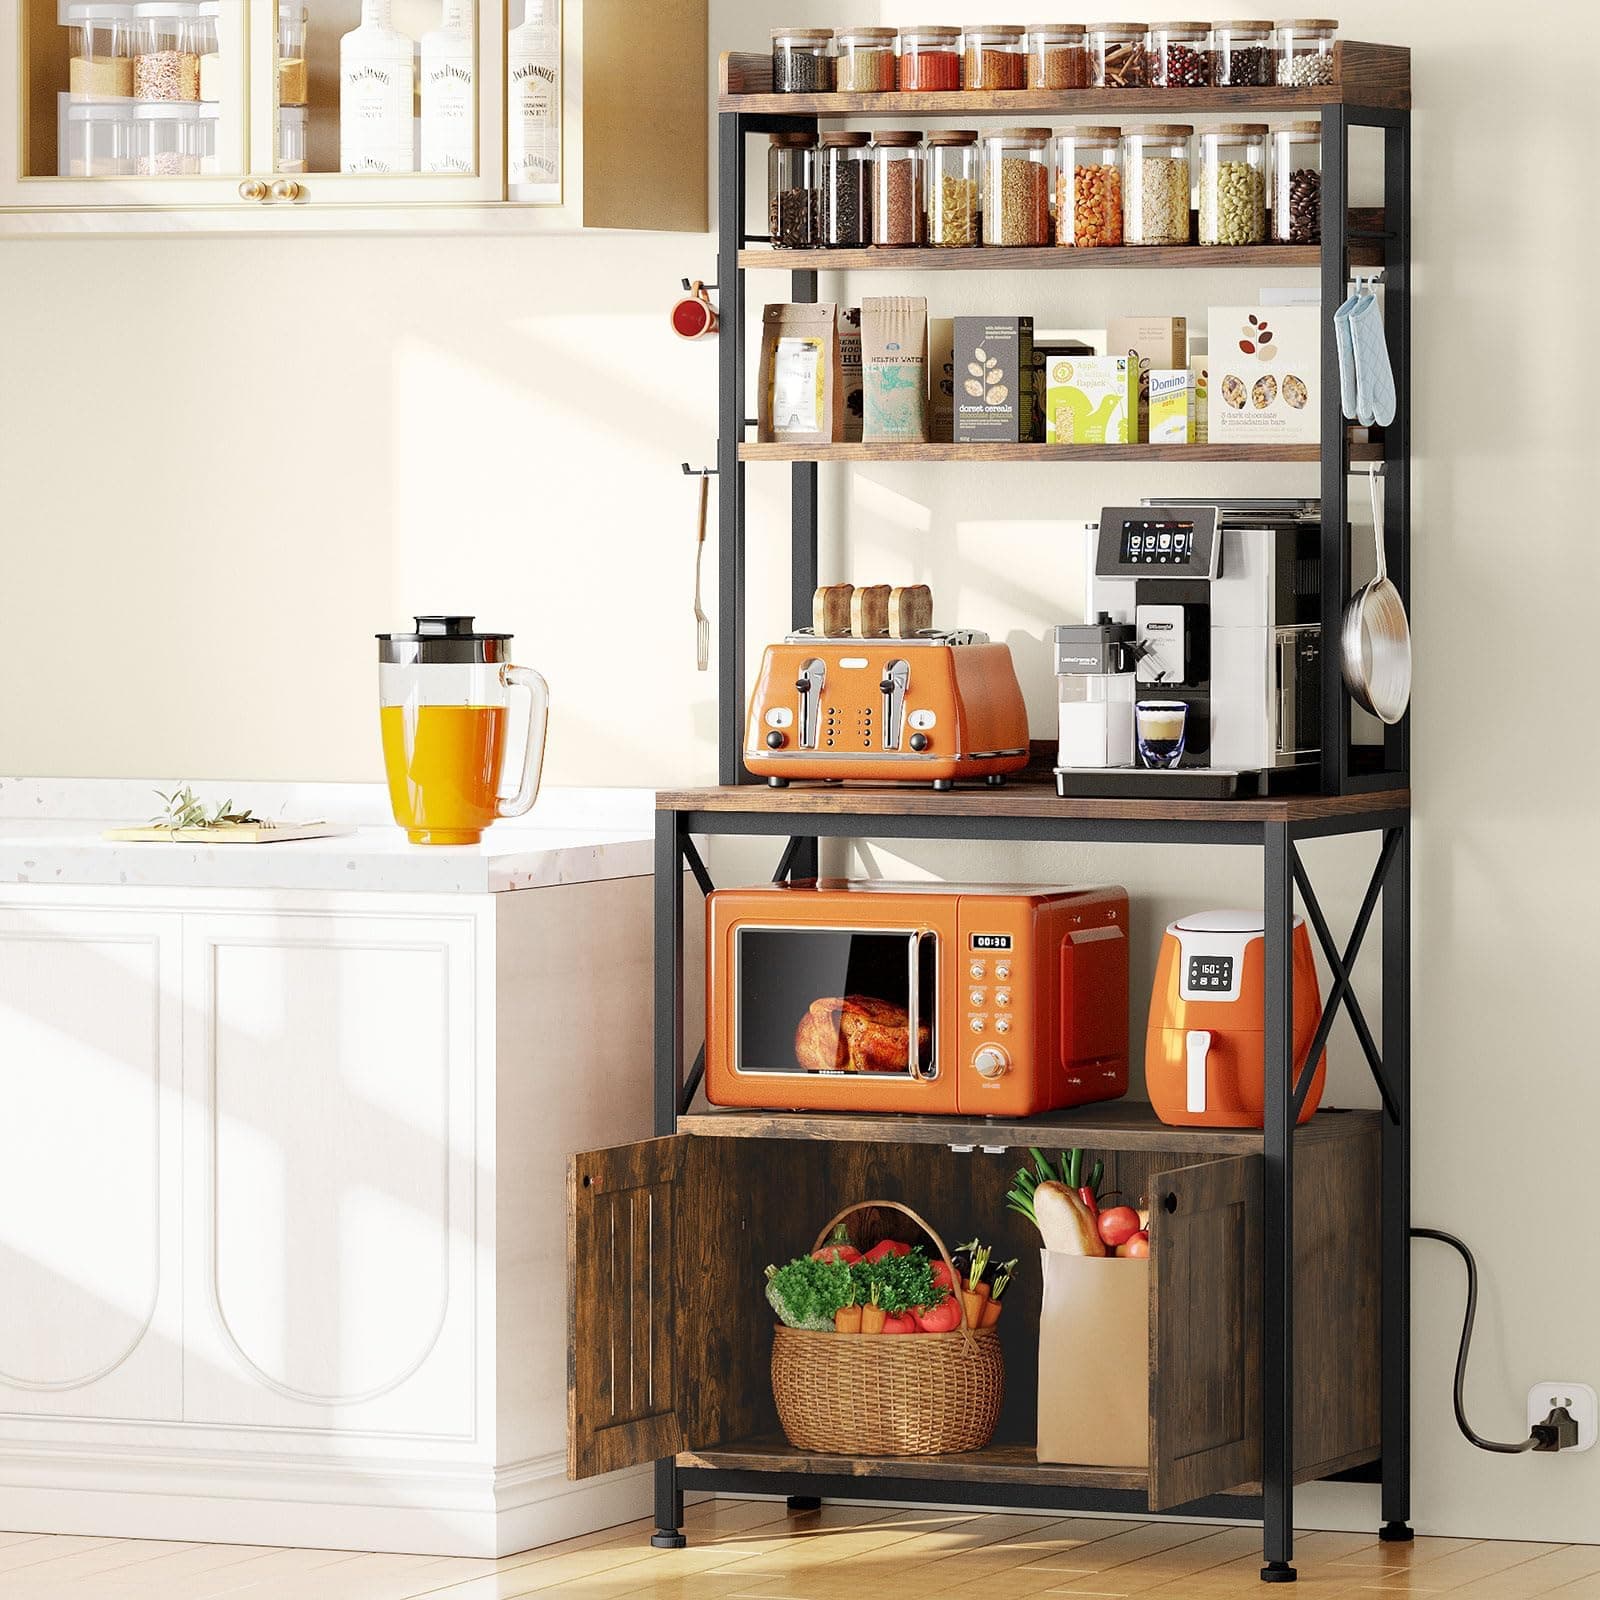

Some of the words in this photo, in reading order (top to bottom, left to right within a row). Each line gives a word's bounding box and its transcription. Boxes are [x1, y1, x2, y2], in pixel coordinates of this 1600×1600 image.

[528, 62, 555, 84] DANIEL'S
[1151, 376, 1186, 391] Domino
[959, 404, 985, 412] dorset
[985, 404, 1013, 412] cereals
[1227, 411, 1243, 419] dark
[1244, 411, 1278, 419] chocolate
[1228, 418, 1270, 426] macadamia
[1270, 418, 1286, 426] bars
[977, 936, 1007, 947] 00:30
